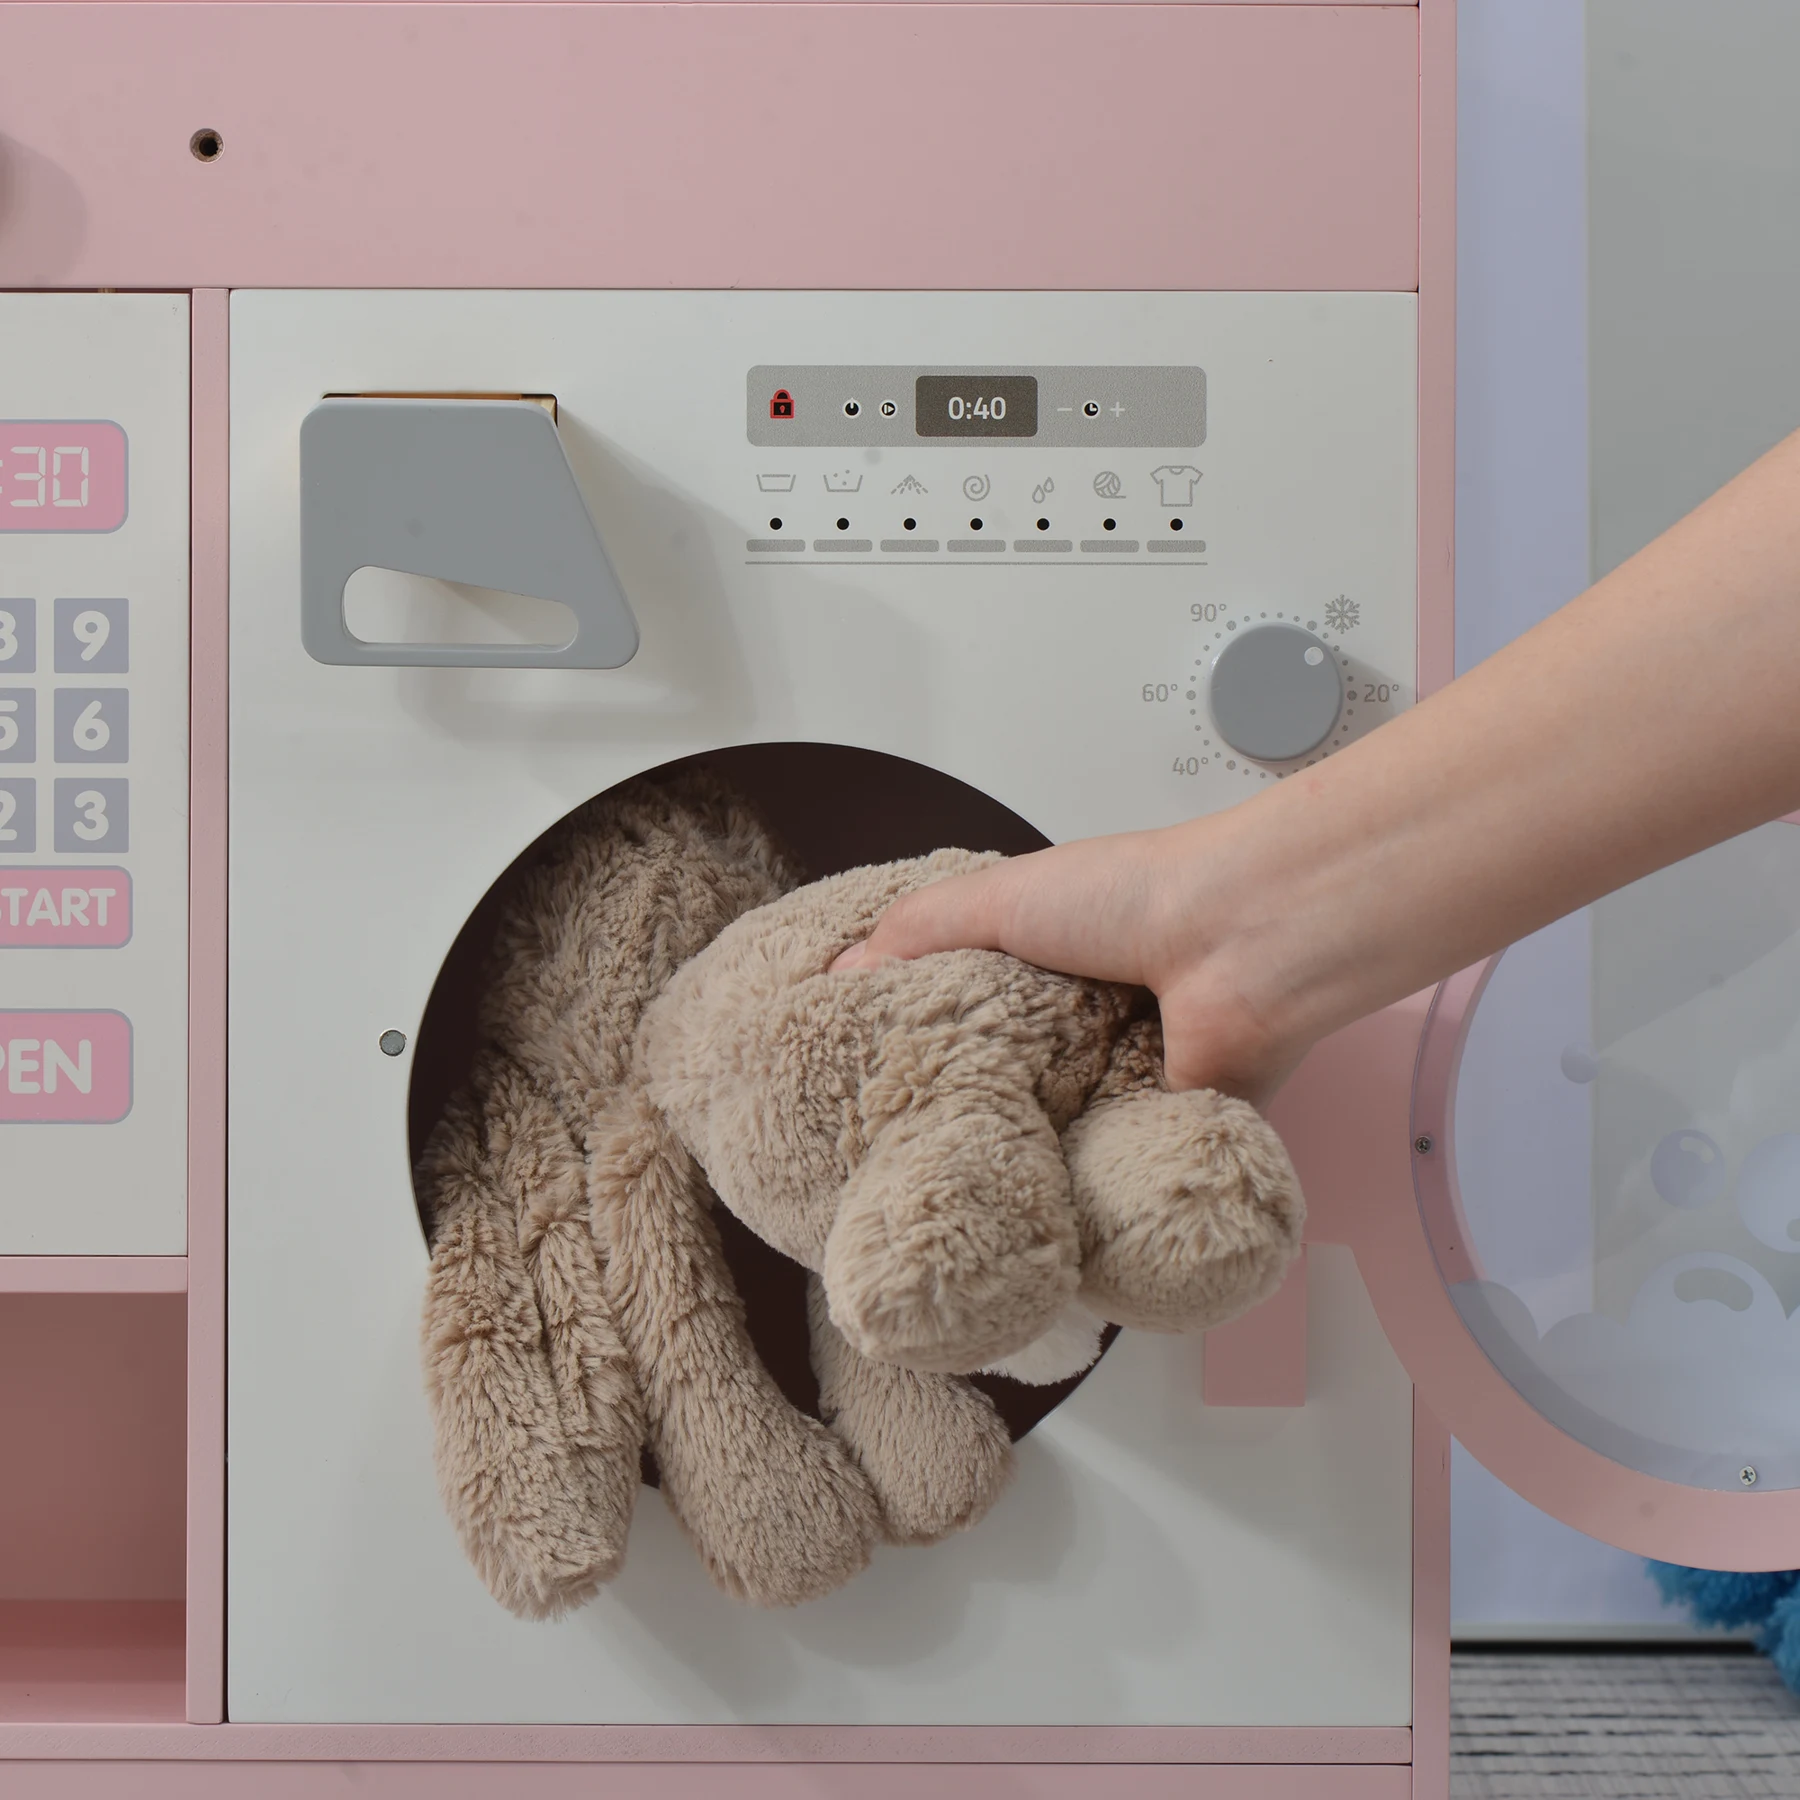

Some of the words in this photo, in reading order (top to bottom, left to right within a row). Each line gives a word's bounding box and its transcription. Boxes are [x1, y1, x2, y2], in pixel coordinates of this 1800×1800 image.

[948, 396, 1007, 420] 0:40
[1190, 603, 1227, 622] 90°
[73, 610, 110, 661] 9
[1142, 683, 1178, 702] 60°
[1363, 684, 1400, 702] 20°
[73, 700, 110, 751] 6
[1172, 757, 1209, 775] 40°
[73, 790, 110, 841] 3
[0, 888, 117, 926] TART
[0, 1039, 92, 1094] EN
